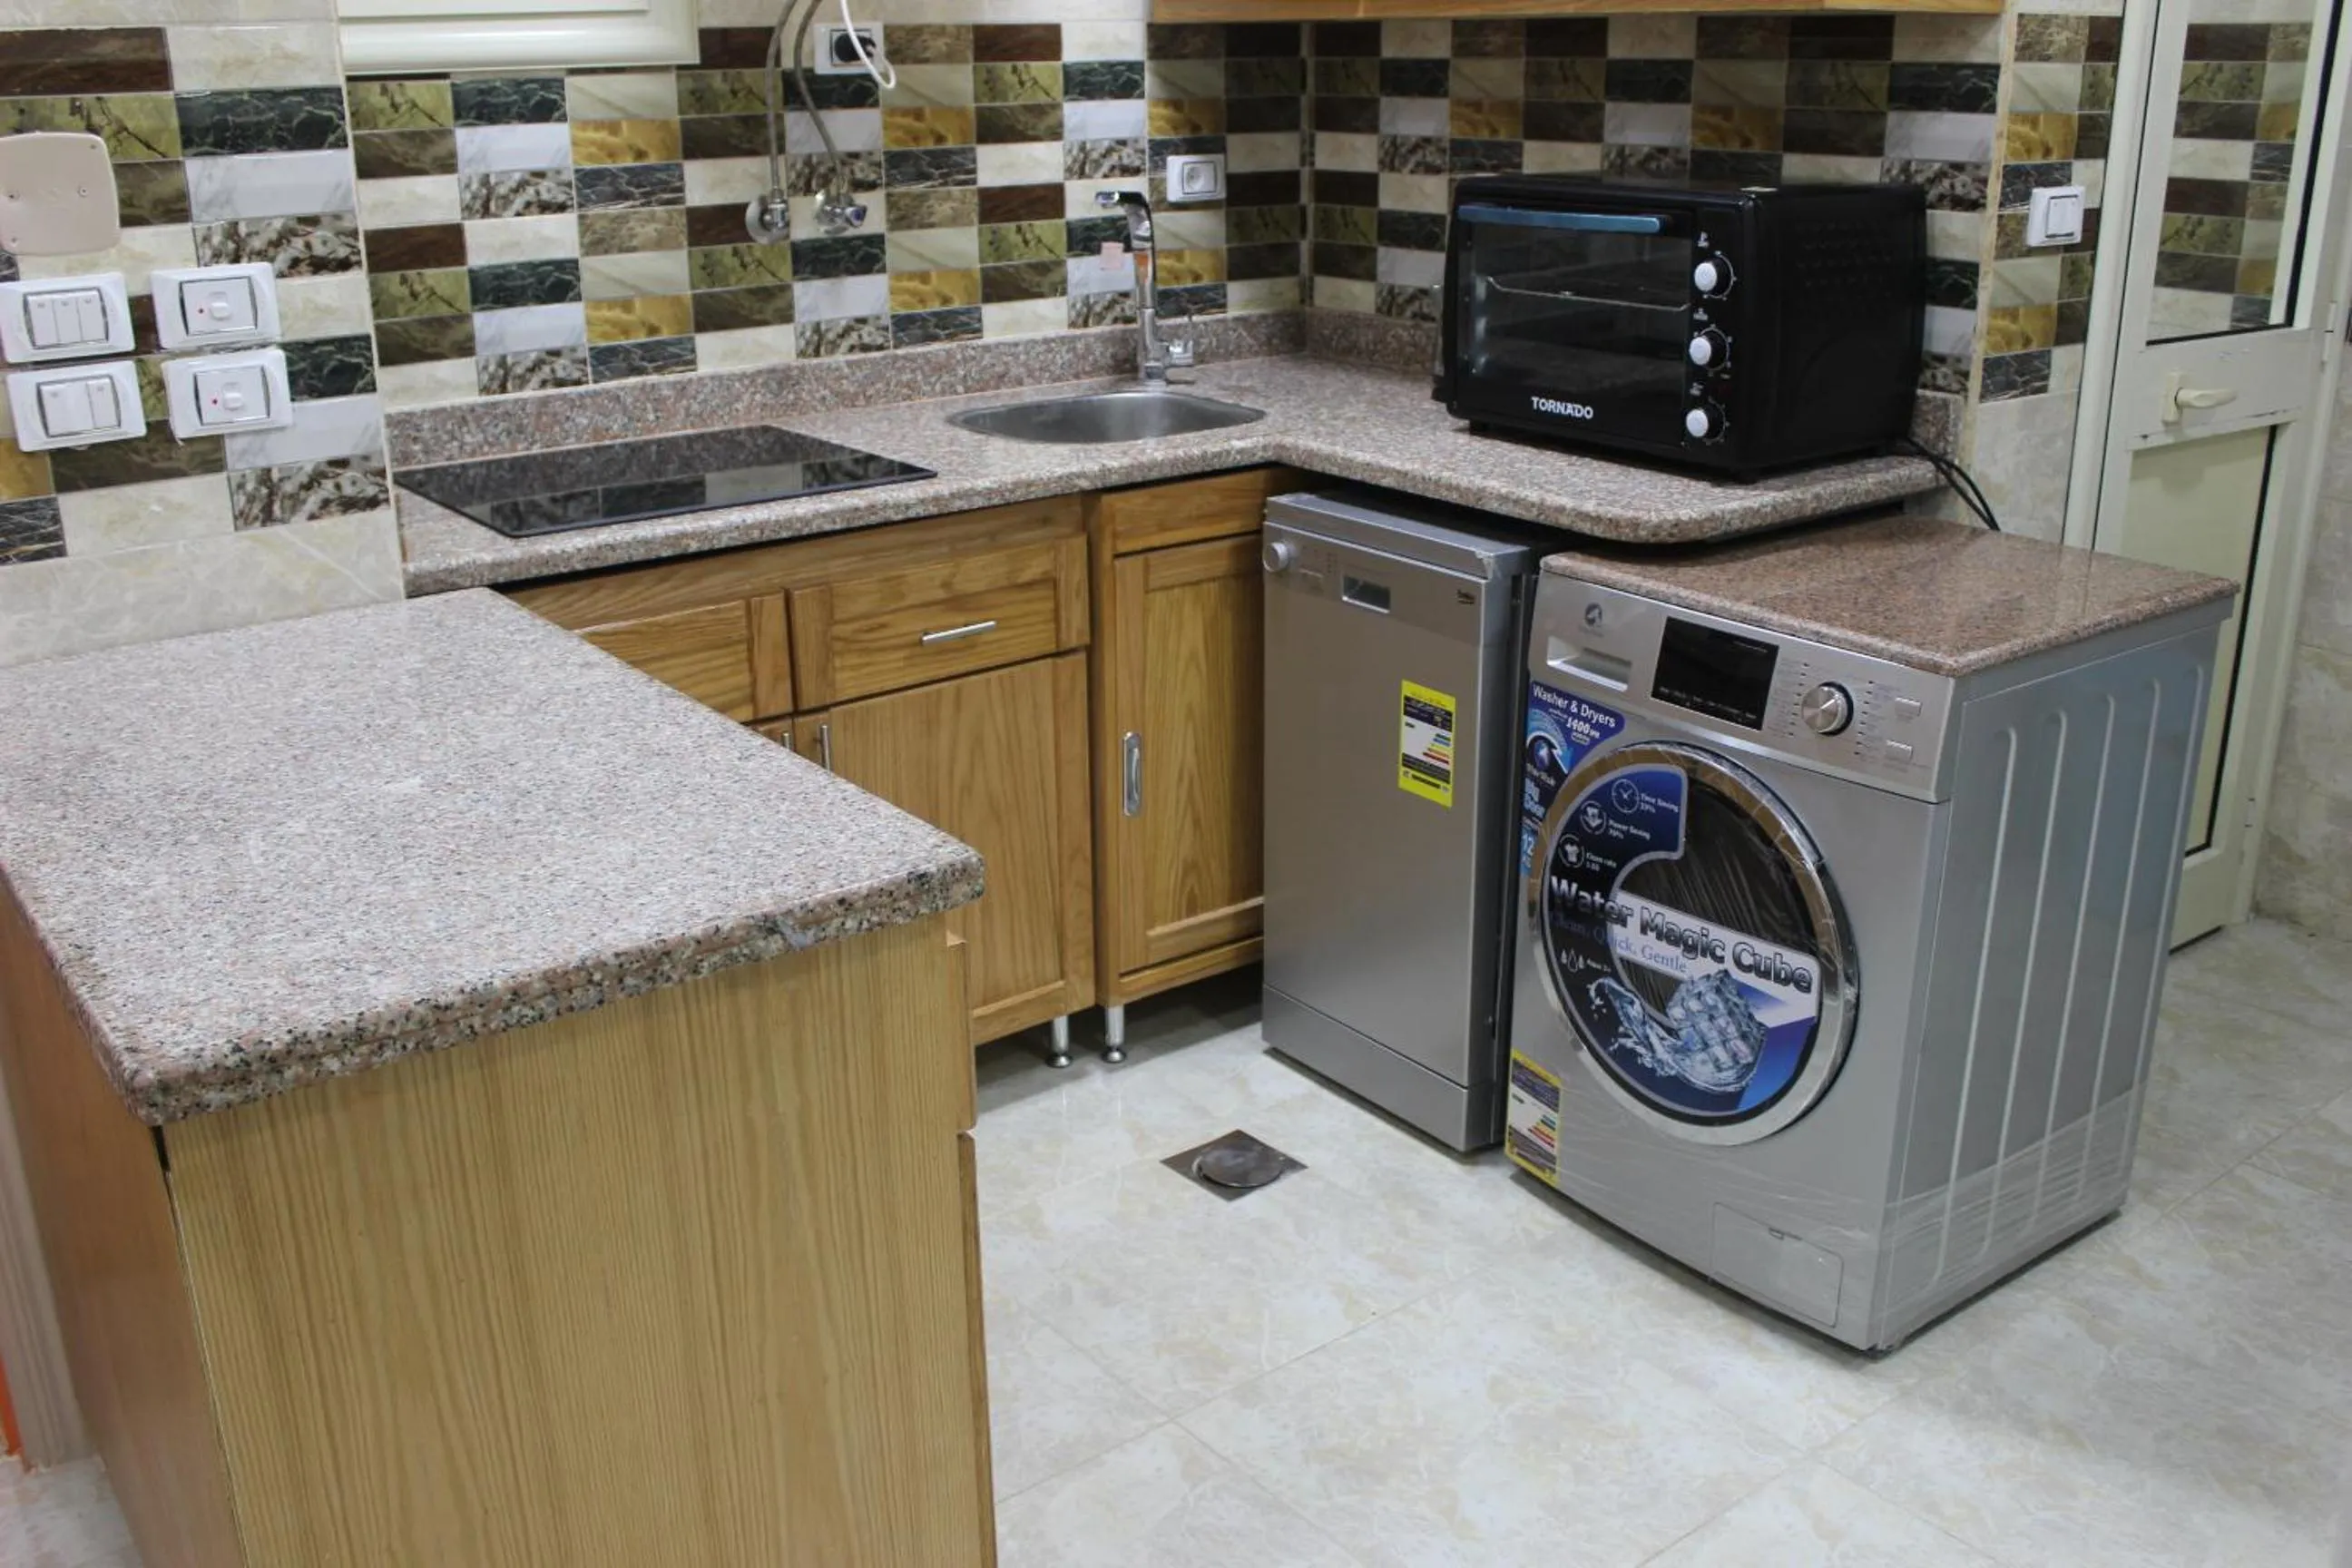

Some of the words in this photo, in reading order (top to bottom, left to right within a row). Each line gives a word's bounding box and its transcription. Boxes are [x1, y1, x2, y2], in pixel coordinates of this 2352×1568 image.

[1531, 396, 1594, 419] TORNADO
[1533, 683, 1569, 709] Washer
[1570, 700, 1579, 713] &
[1581, 703, 1616, 728] Dryers
[1550, 875, 1634, 928] Water
[1639, 906, 1725, 963] Magic
[1732, 941, 1813, 994] Cube
[1641, 941, 1689, 974] Gentle
